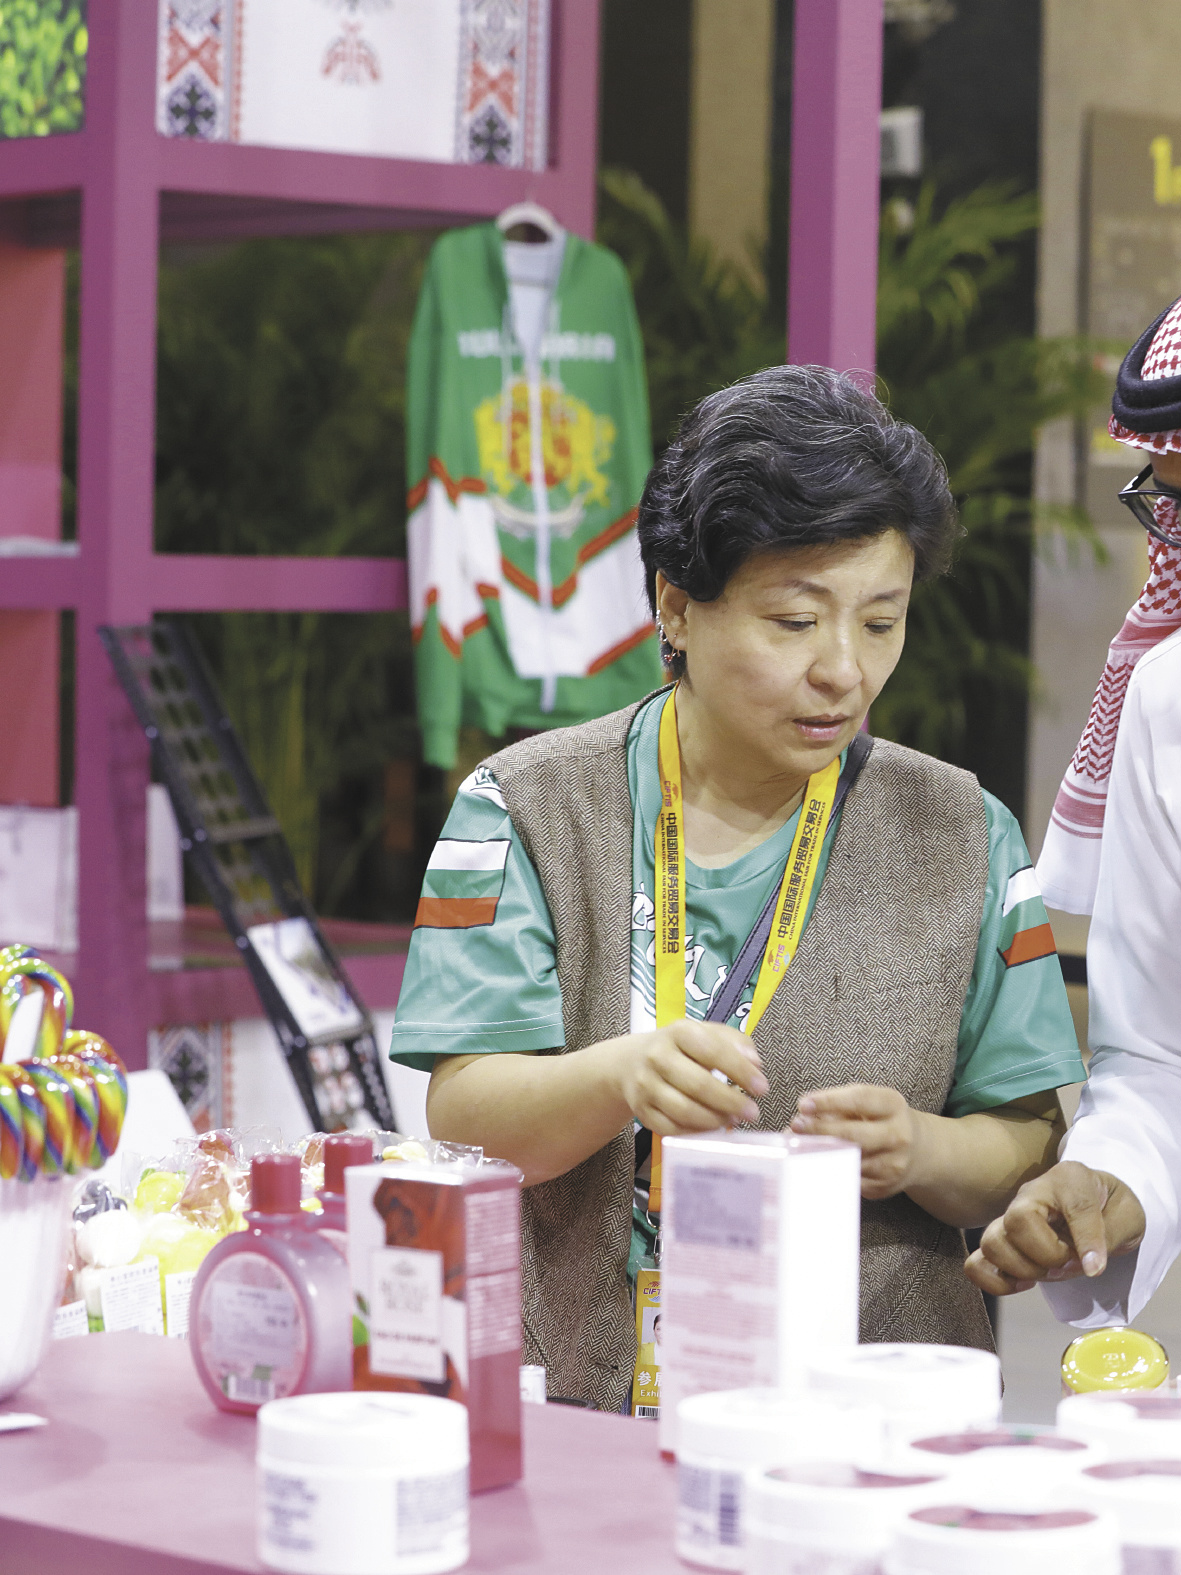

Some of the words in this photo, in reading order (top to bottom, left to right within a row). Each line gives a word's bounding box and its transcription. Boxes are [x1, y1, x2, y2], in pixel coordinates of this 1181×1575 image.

[664, 780, 672, 807] CIFTIS
[778, 799, 821, 938] 中国国际服务贸易交易会
[666, 812, 679, 954] 中国国际服务贸易交易会
[772, 944, 785, 972] CIFTIS
[643, 1287, 662, 1295] CIFT
